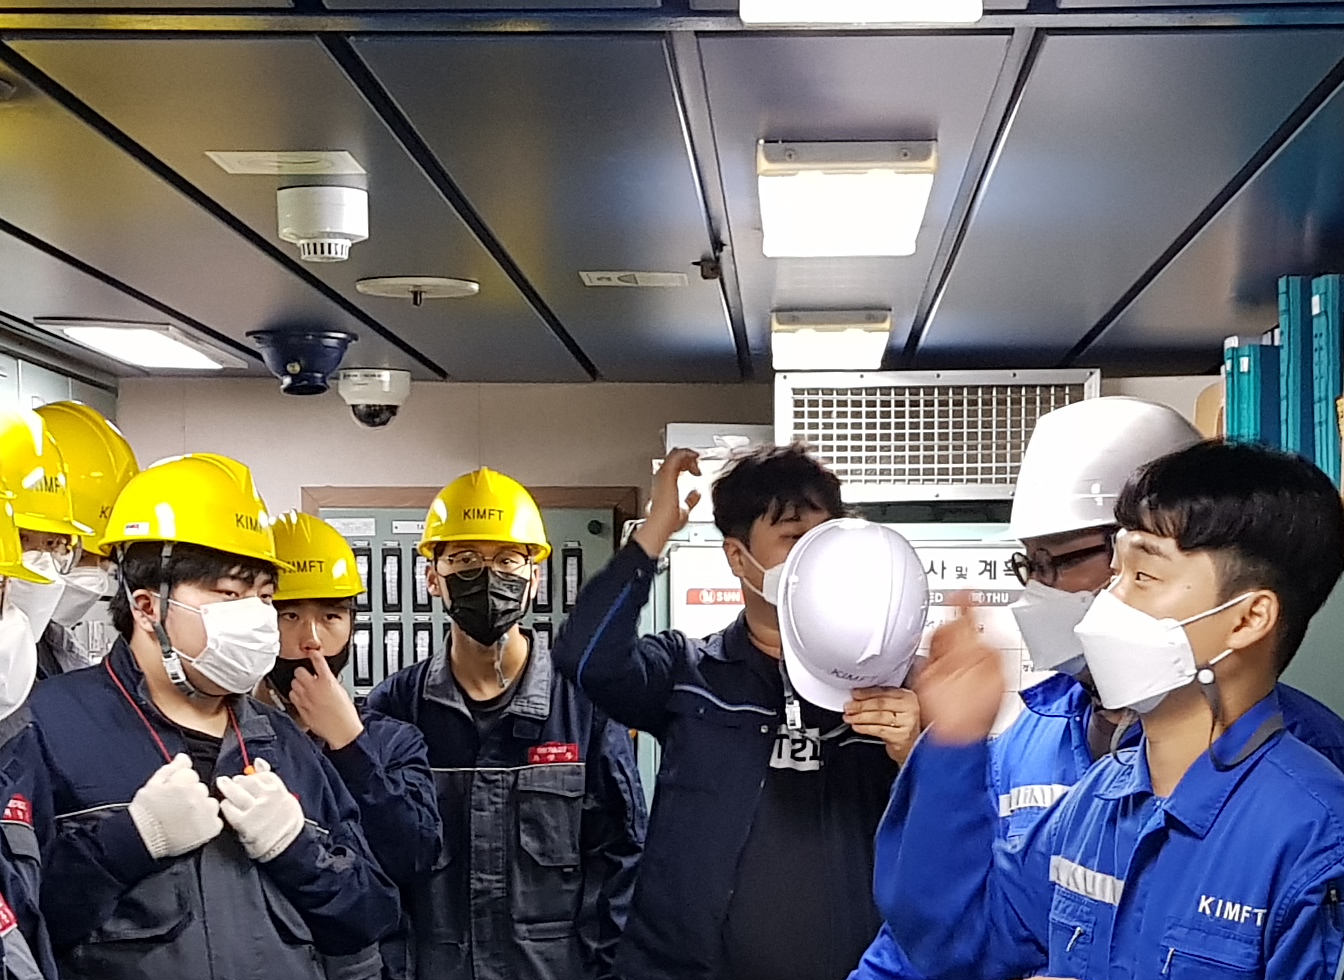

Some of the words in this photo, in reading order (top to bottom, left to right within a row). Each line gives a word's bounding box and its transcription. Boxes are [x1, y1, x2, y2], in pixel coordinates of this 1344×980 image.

[463, 508, 504, 521] KIMFT
[716, 592, 741, 602] SUN
[986, 592, 1009, 602] THU
[1198, 895, 1268, 927] KIMFT
